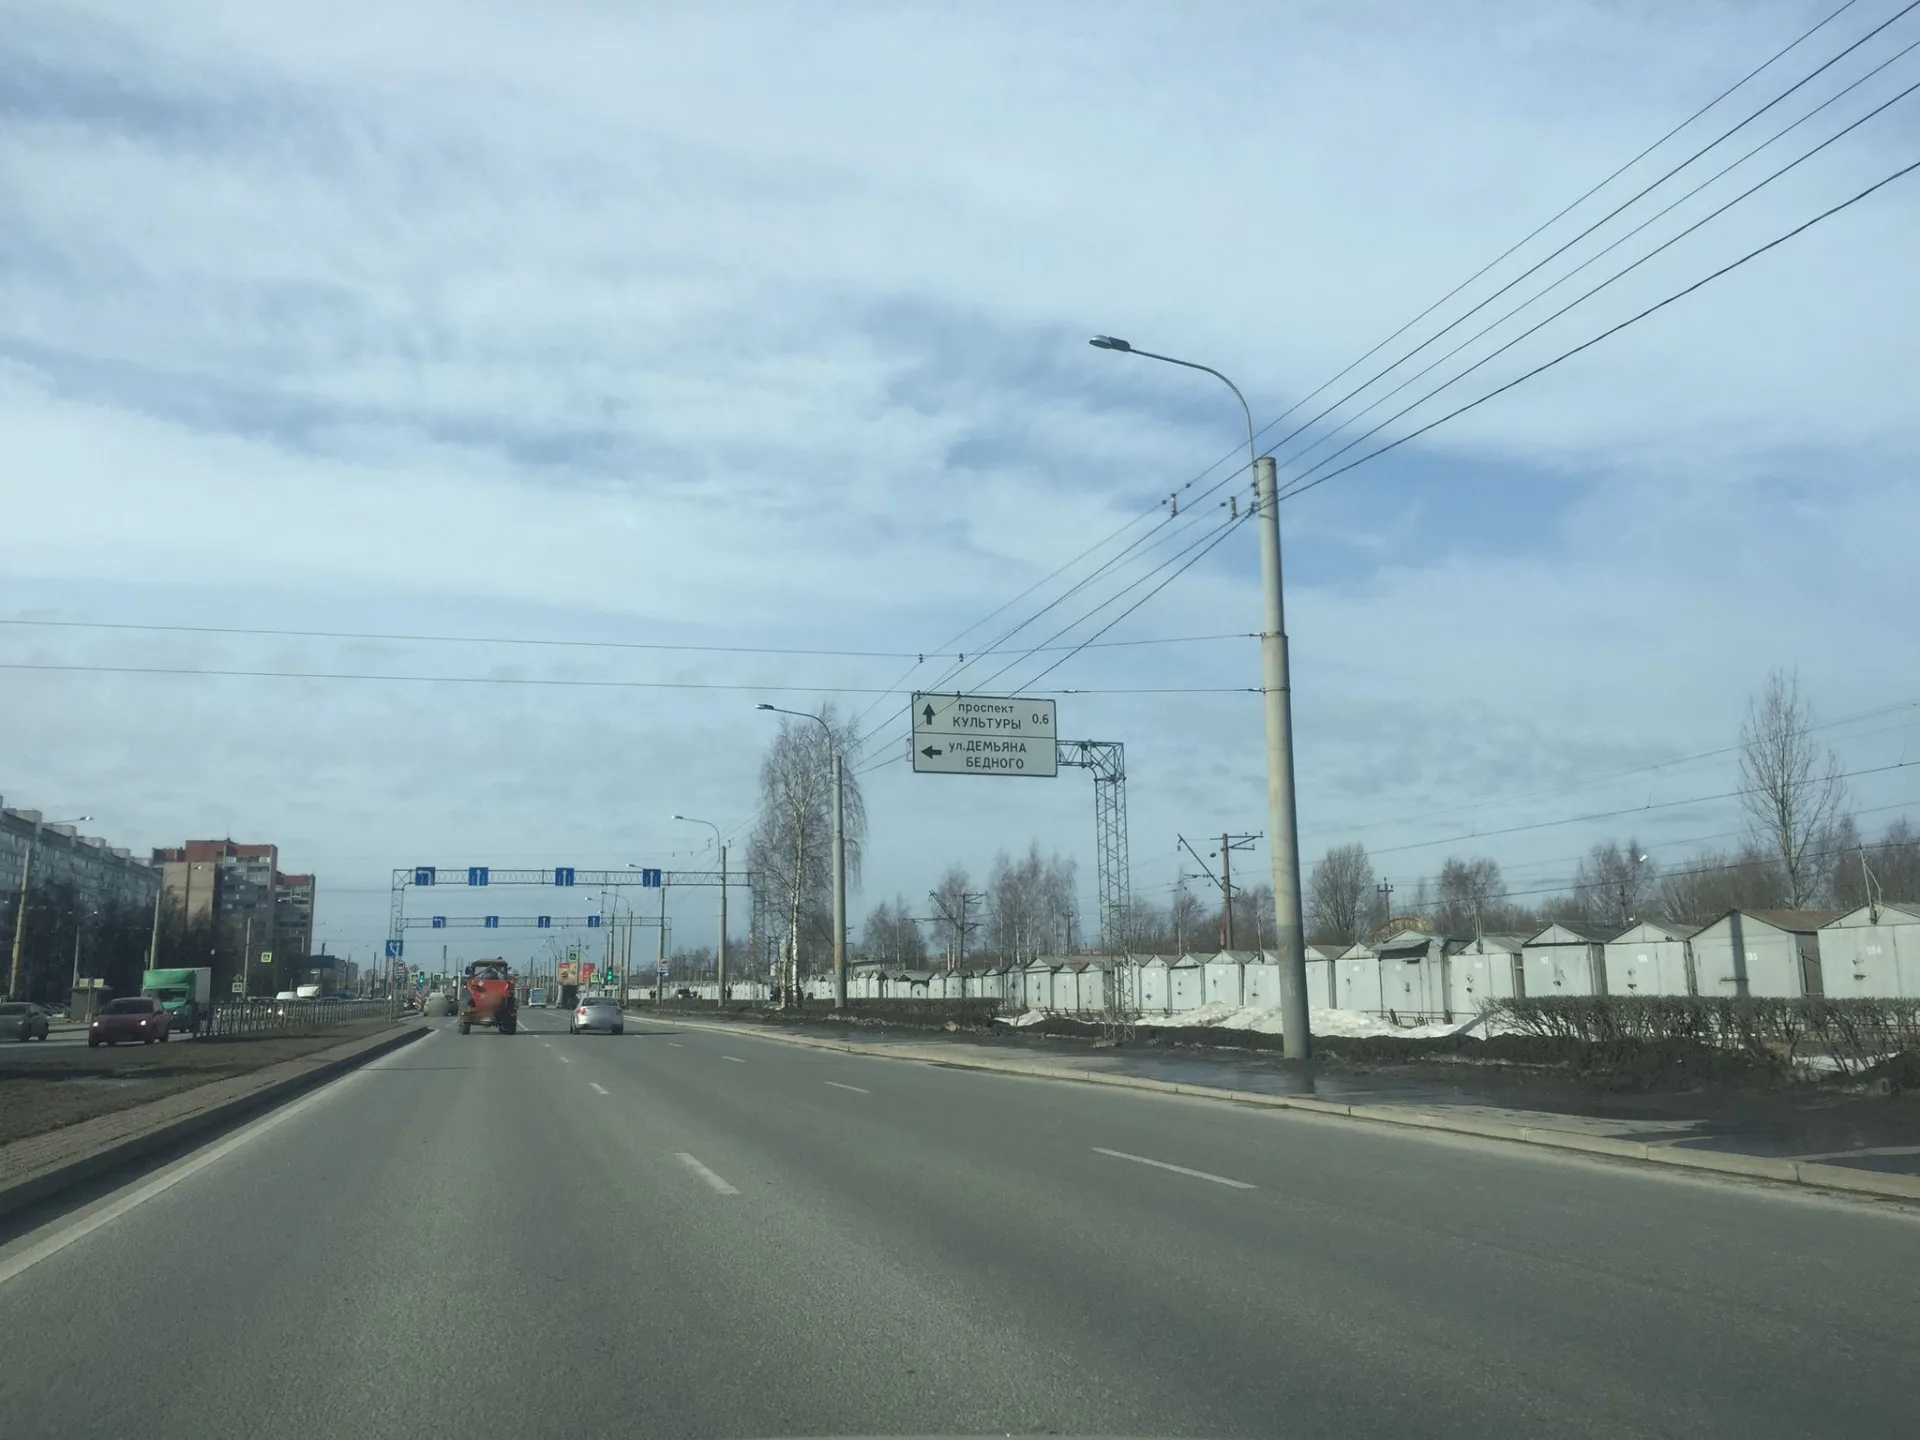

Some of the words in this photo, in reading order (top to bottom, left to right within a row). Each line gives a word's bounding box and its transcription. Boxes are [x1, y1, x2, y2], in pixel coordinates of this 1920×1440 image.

[959, 703, 1014, 714] проспект
[953, 716, 1021, 730] КУЛЬТУРЫ
[1032, 713, 1049, 725] 0.6
[966, 757, 1024, 770] БЕДНОГО
